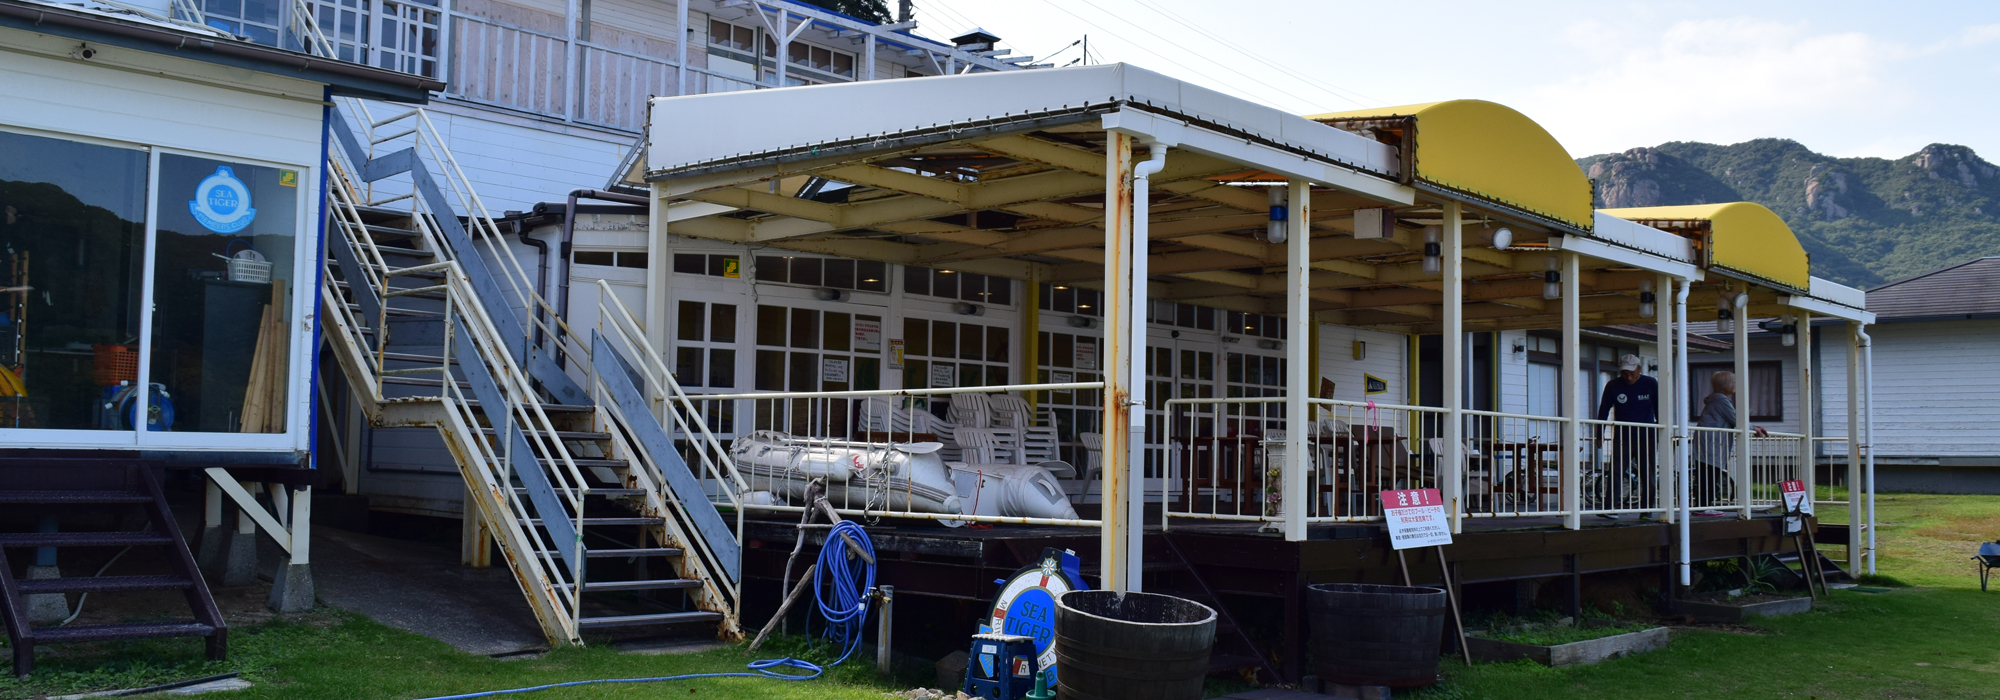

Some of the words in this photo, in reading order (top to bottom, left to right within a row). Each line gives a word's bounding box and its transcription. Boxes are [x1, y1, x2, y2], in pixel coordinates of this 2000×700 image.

[208, 197, 238, 208] TIGER
[215, 190, 232, 198] SEA
[198, 212, 231, 230] MEMBERS
[232, 217, 248, 229] CLUB
[1020, 601, 1046, 622] SEA
[1007, 616, 1050, 643] TIGER
